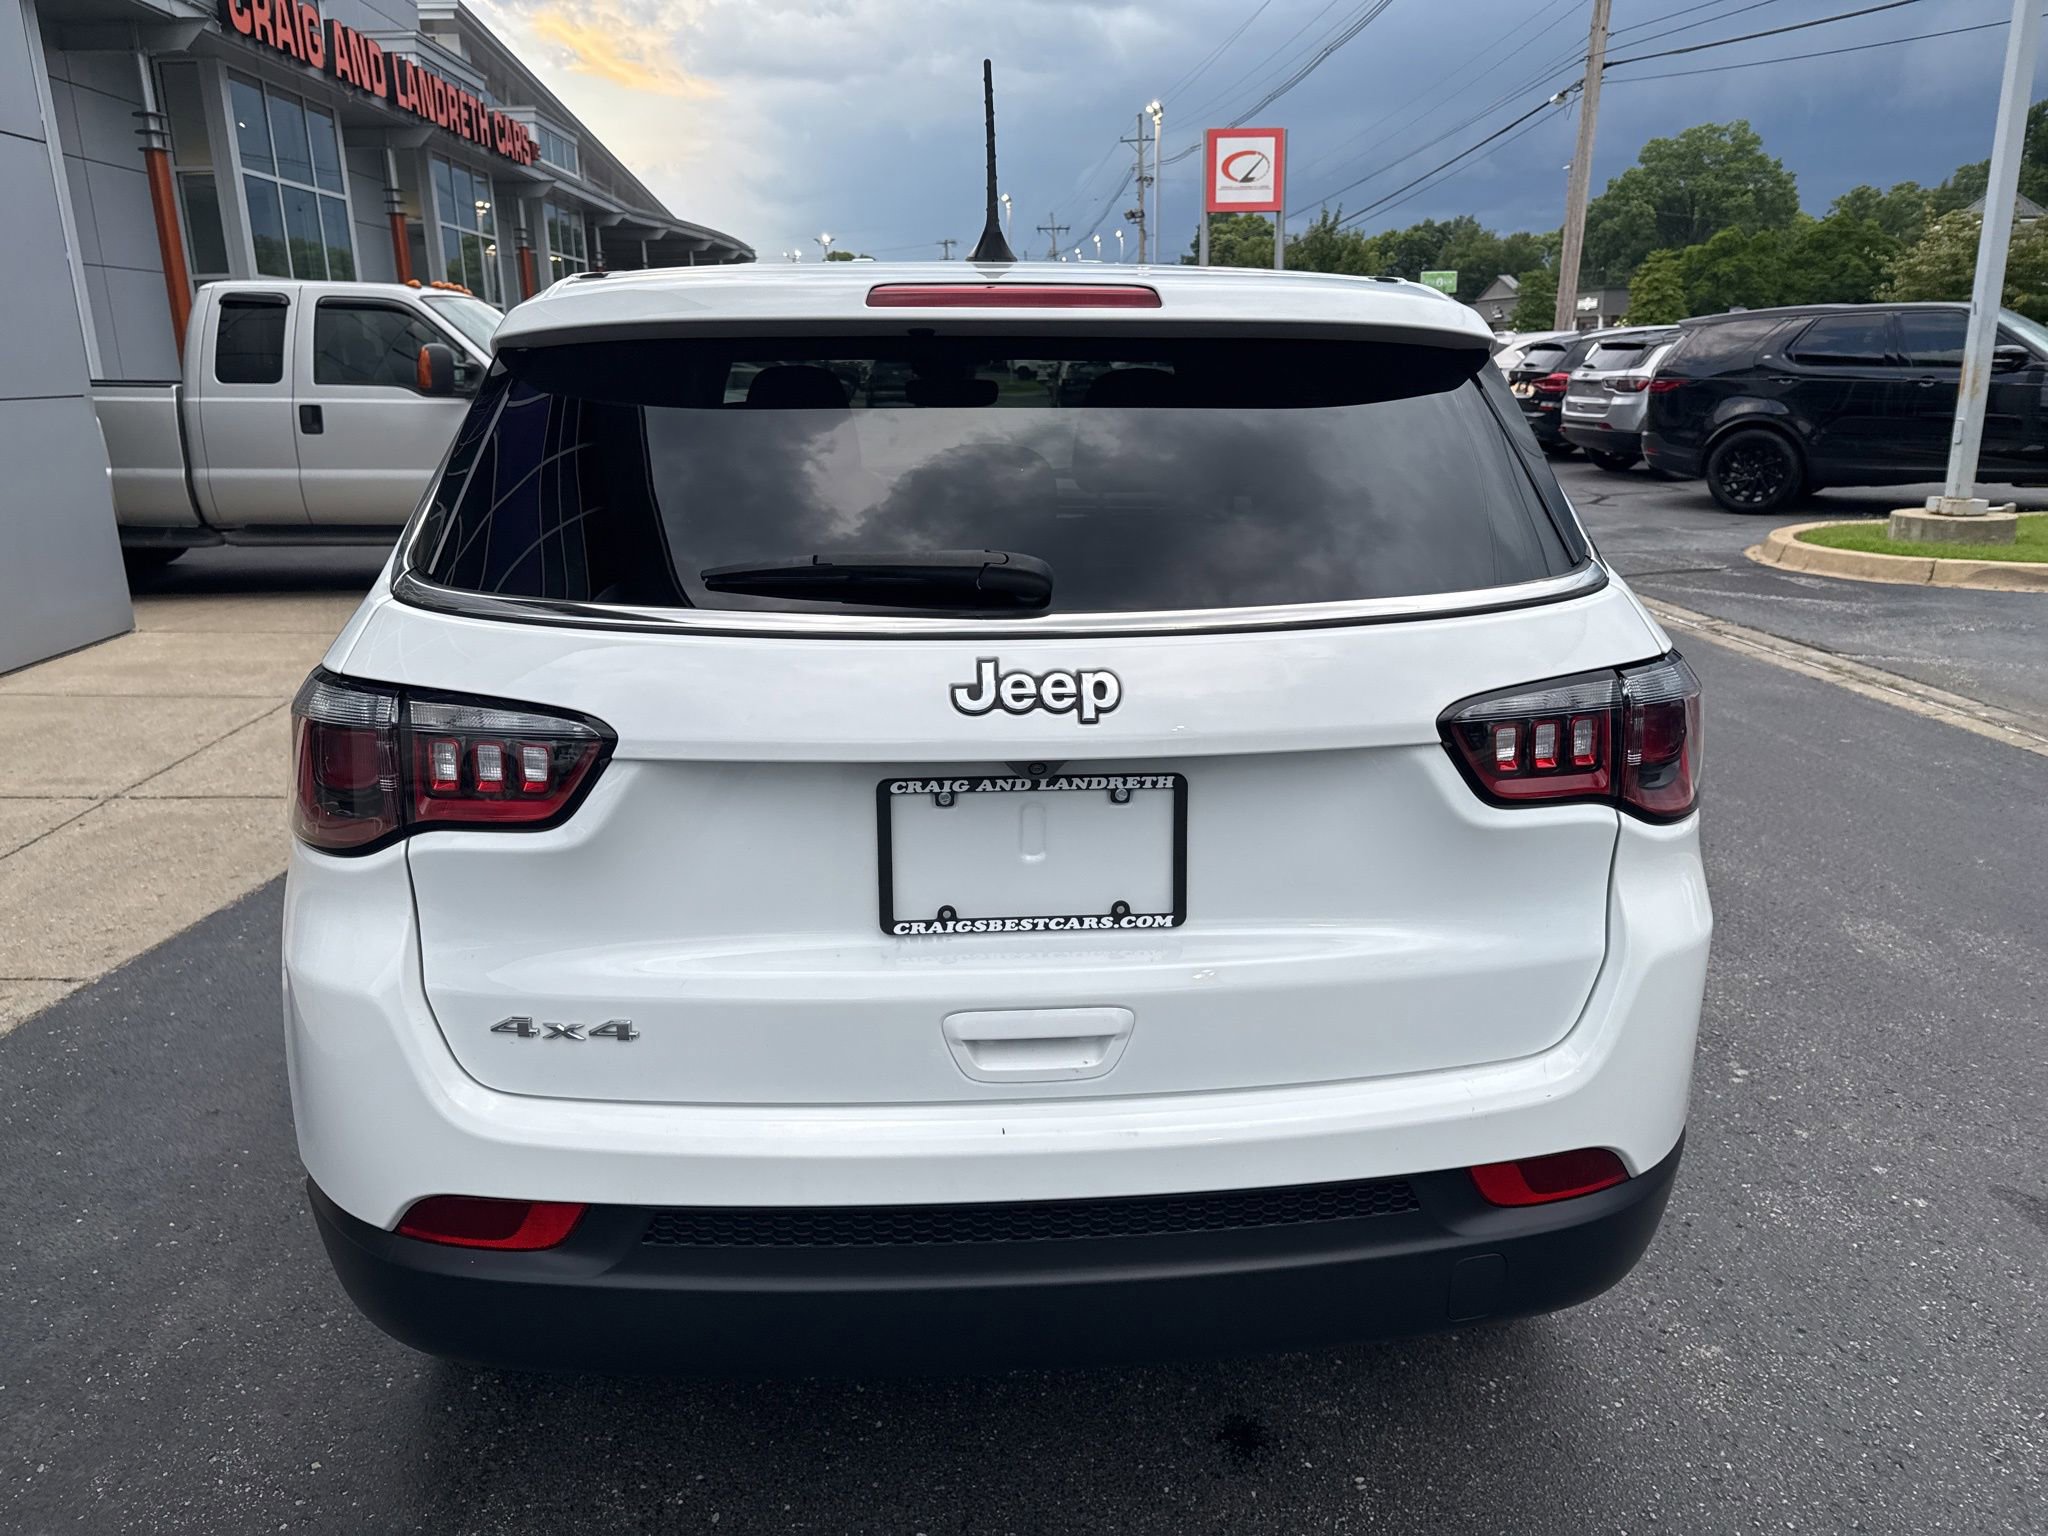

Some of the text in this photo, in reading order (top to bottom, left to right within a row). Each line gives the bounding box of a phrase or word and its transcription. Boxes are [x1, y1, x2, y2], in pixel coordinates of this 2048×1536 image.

[333, 19, 388, 98] AND
[392, 52, 492, 148] LANDRETH
[493, 110, 533, 167] CARS
[950, 658, 1122, 724] Jeep
[890, 775, 1176, 794] CRAIG AND LANDRETH
[893, 915, 1175, 935] CRAIGSBESTCARS.COM
